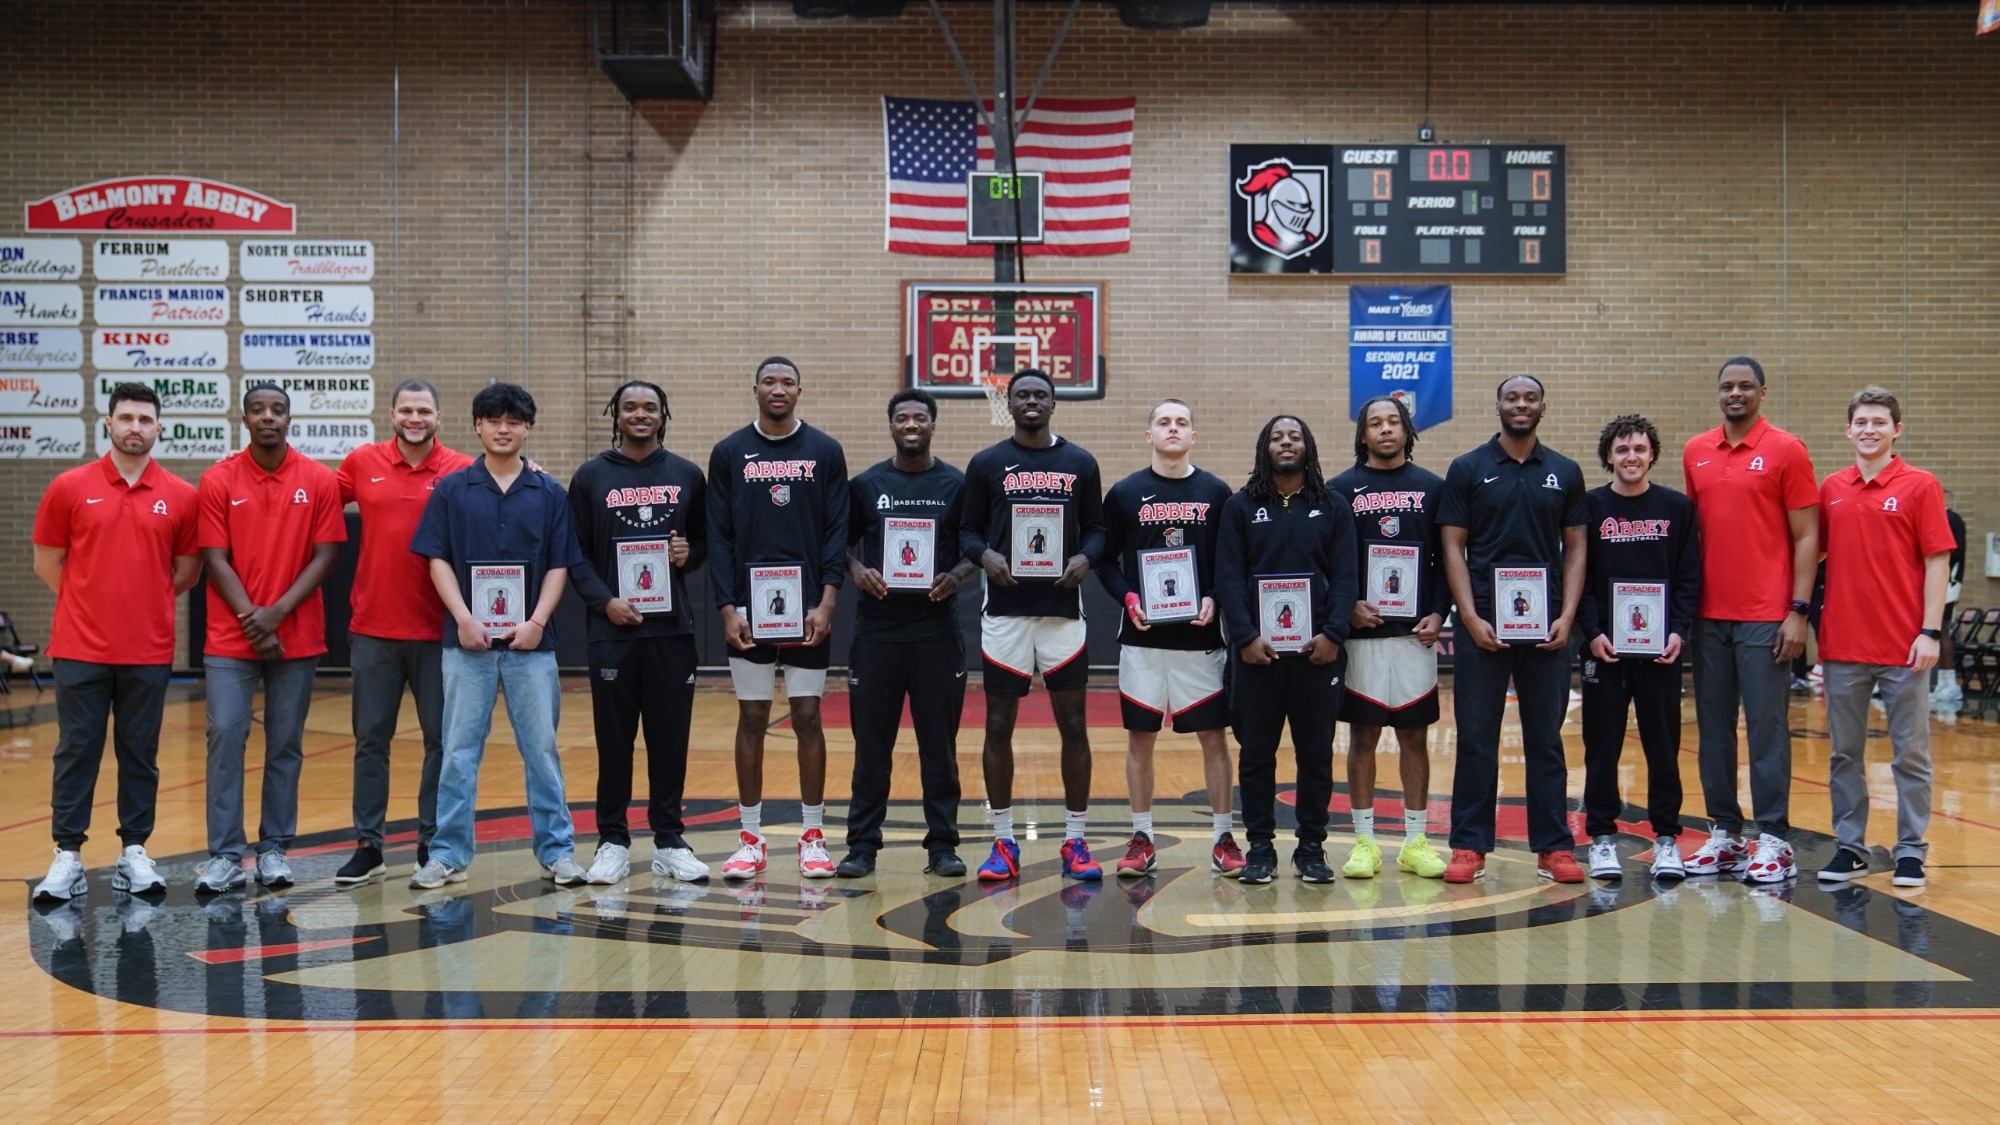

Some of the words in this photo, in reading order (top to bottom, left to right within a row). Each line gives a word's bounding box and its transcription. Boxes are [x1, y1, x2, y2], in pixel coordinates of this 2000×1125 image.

[1342, 149, 1397, 164] GUEST
[1505, 151, 1554, 165] HOME
[1373, 169, 1390, 200] 0
[1532, 170, 1551, 201] 0
[52, 183, 176, 222] BELMONT
[183, 182, 269, 223] ABBEY
[1408, 196, 1456, 209] PERIOD
[105, 208, 215, 230] Crusaders
[1354, 225, 1387, 236] FOULS
[1416, 225, 1486, 236] PLAYER-FOUL
[1514, 225, 1546, 236] FOULS
[0, 247, 24, 261] ON
[100, 242, 169, 255] FERRUM
[247, 245, 288, 257] NORTH
[293, 245, 367, 257] GREENVILLE
[1366, 240, 1381, 263] 0
[1525, 240, 1541, 263] 0
[140, 258, 219, 277] Panthers
[287, 259, 368, 280] Trailblazers
[100, 288, 162, 300] FRANCIS
[168, 288, 225, 300] MARION
[246, 289, 324, 303] SHORTER
[14, 302, 78, 320] Hawks
[151, 301, 224, 321] Patriots
[305, 303, 368, 323] Hawks
[929, 298, 1074, 323] BELONT
[1367, 305, 1391, 314] MAKE
[1391, 305, 1401, 314] IT
[1400, 300, 1434, 318] YOURS
[103, 332, 170, 345] KING
[244, 334, 306, 347] SOUTHERN
[310, 334, 371, 347] WESLEYAN
[949, 326, 1057, 351] ABEY
[1353, 329, 1384, 342] AWARD
[1385, 329, 1397, 342] OF
[1397, 329, 1448, 342] EXCELLENCE
[126, 349, 216, 367] Tornado
[295, 349, 371, 366] Warriors
[1364, 351, 1405, 363] SECOND
[1405, 351, 1437, 363] PLACE
[1381, 363, 1420, 380] 2021
[282, 378, 370, 391] PEMBROKE
[28, 389, 78, 408] Lions
[309, 390, 368, 410] Braves
[174, 423, 225, 440] OLIVE
[307, 424, 369, 438] HARRIS
[743, 460, 817, 480] ABBEY
[1003, 471, 1077, 491] ABBEY
[606, 485, 681, 508] ABBEY
[1352, 491, 1425, 513] ABBEY
[1138, 502, 1210, 522] ABBEY
[889, 520, 931, 528] CRUSADERS
[1599, 516, 1671, 540] ABBEY
[620, 543, 665, 552] CRUSADERS
[1610, 535, 1660, 543] BASKETBALL
[1146, 552, 1188, 562] CRUSADERS
[1372, 548, 1415, 556] CRUSADERS
[754, 569, 798, 578] CRUSADERS
[1499, 570, 1542, 578] CRUSADERS
[1616, 584, 1661, 593] CRUSADERS
